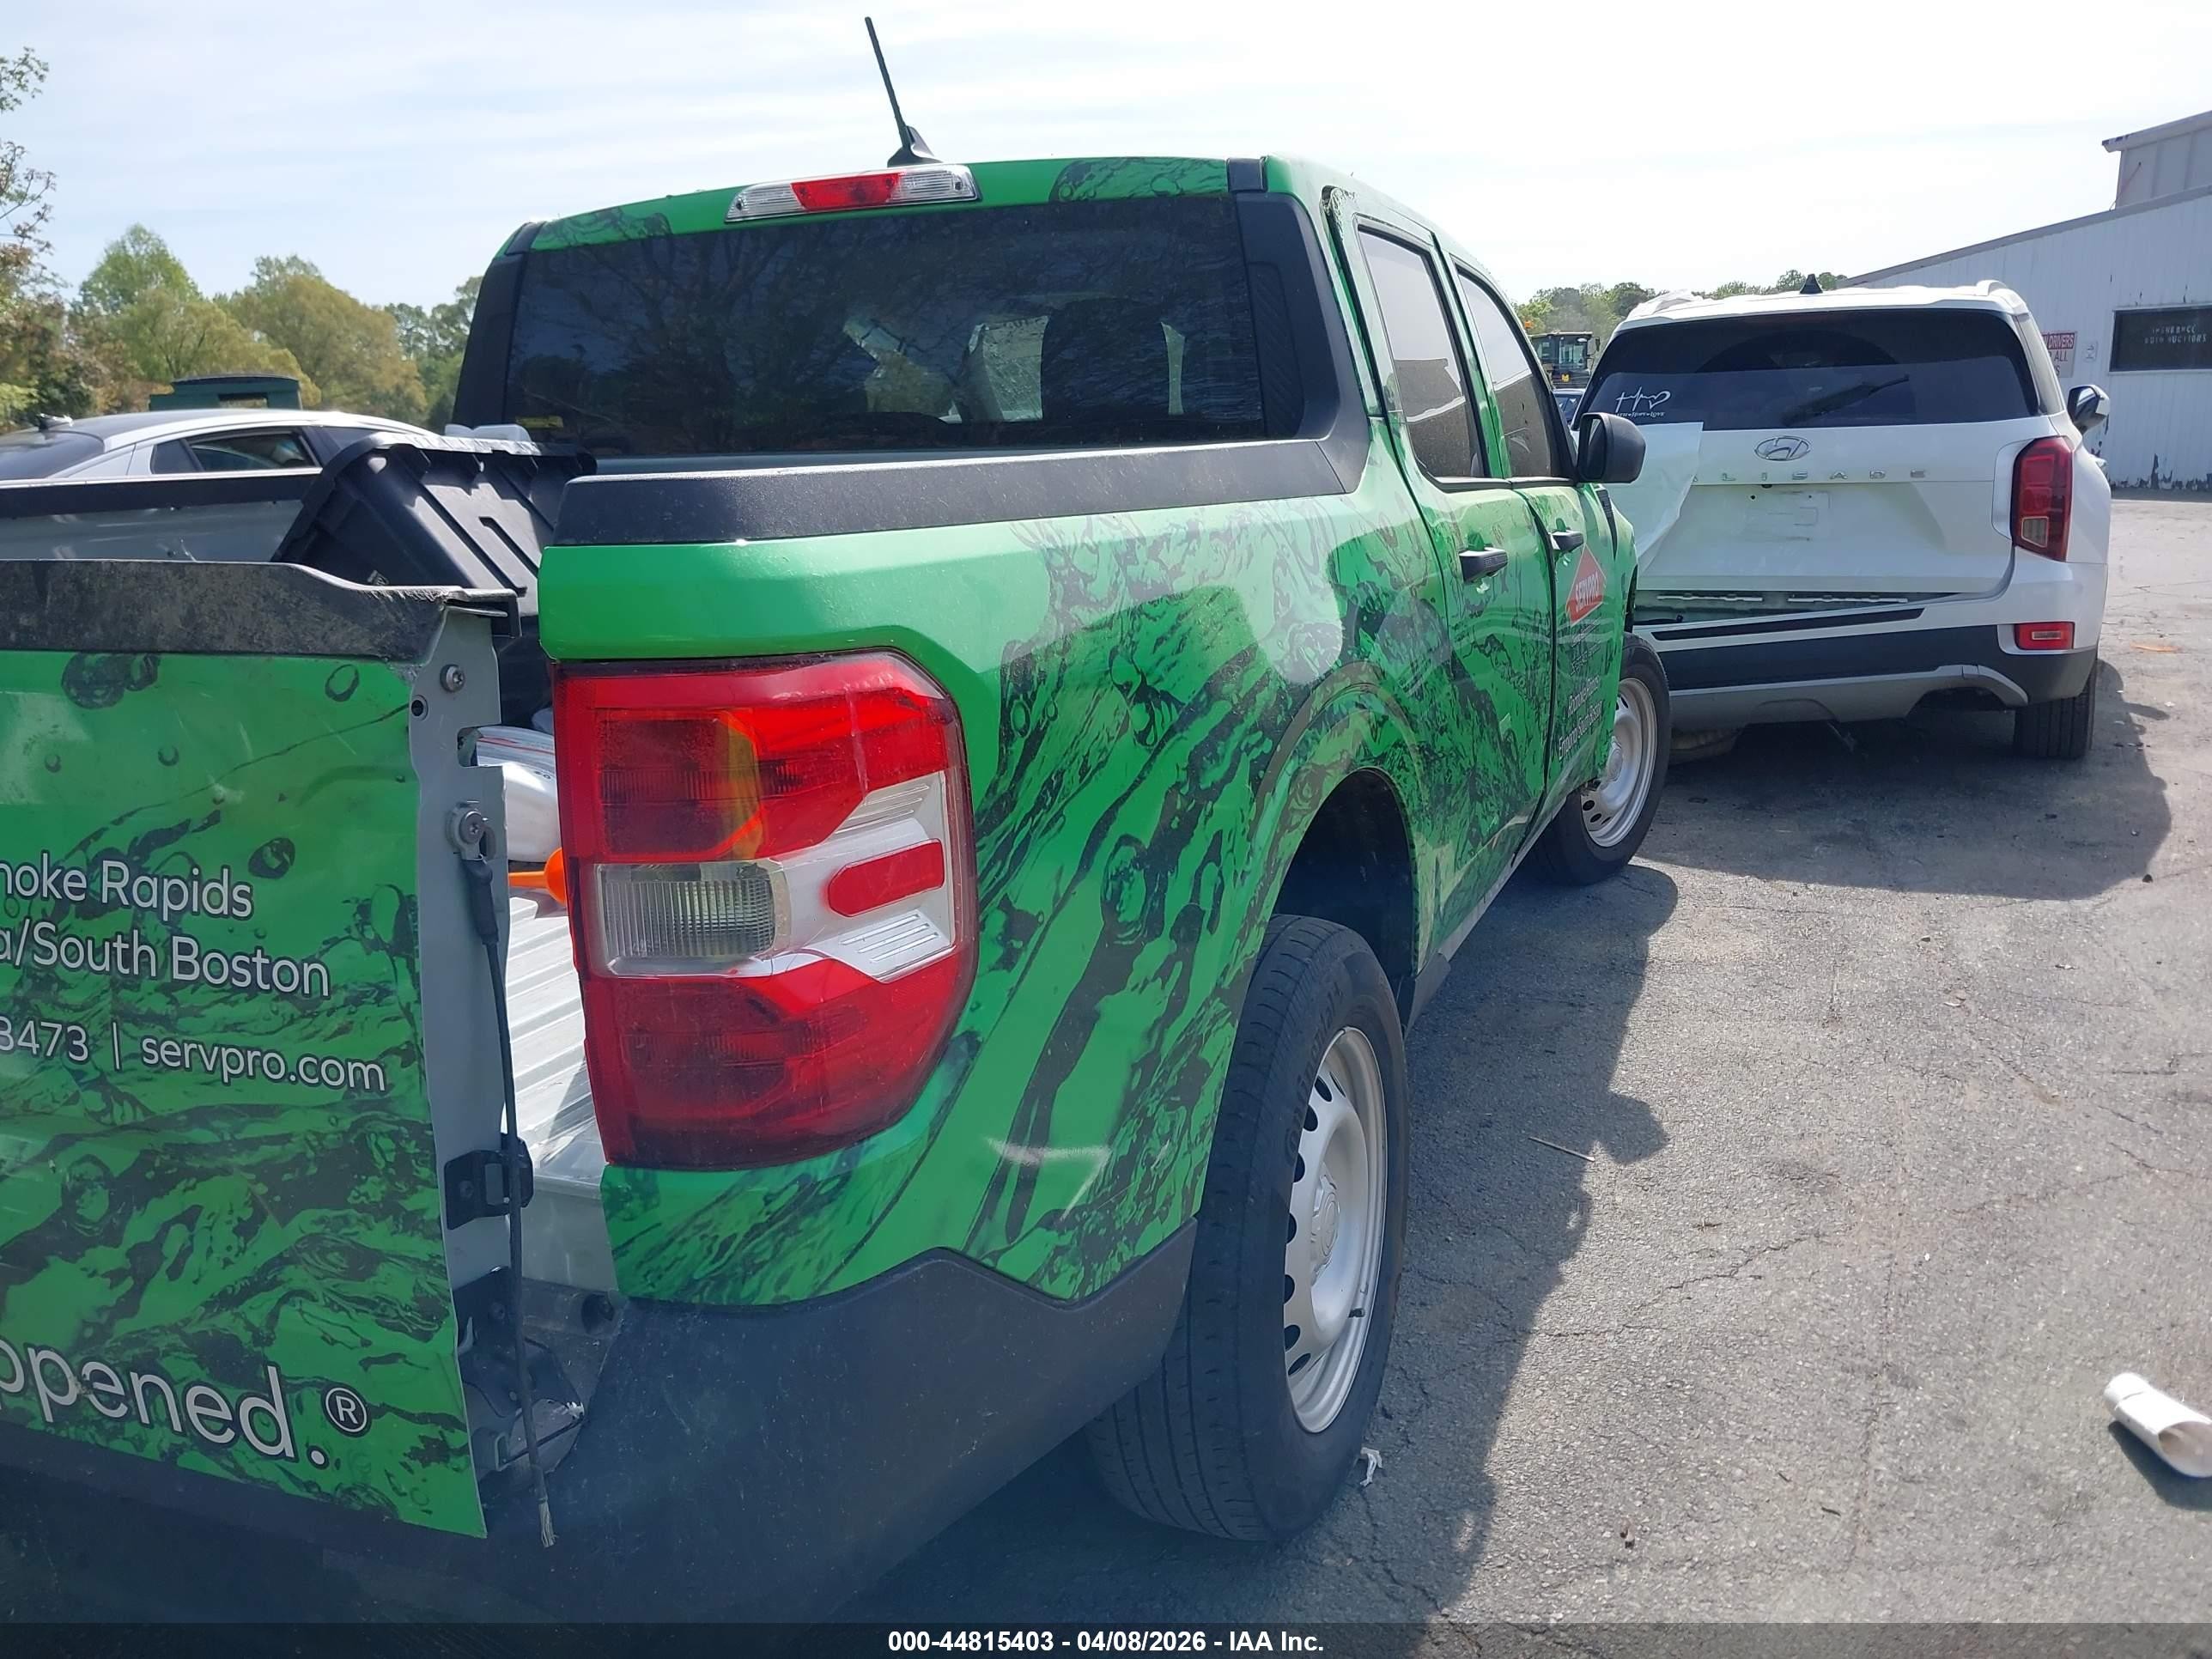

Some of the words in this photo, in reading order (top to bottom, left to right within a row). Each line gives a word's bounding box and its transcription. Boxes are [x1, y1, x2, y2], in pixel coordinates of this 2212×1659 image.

[2048, 334, 2075, 349] DRIVERS
[2054, 349, 2068, 362] ALL
[1575, 571, 1599, 612] SERVPRO
[101, 860, 252, 921] Rapids
[172, 935, 330, 997] Boston
[142, 1036, 386, 1091] servpro.com
